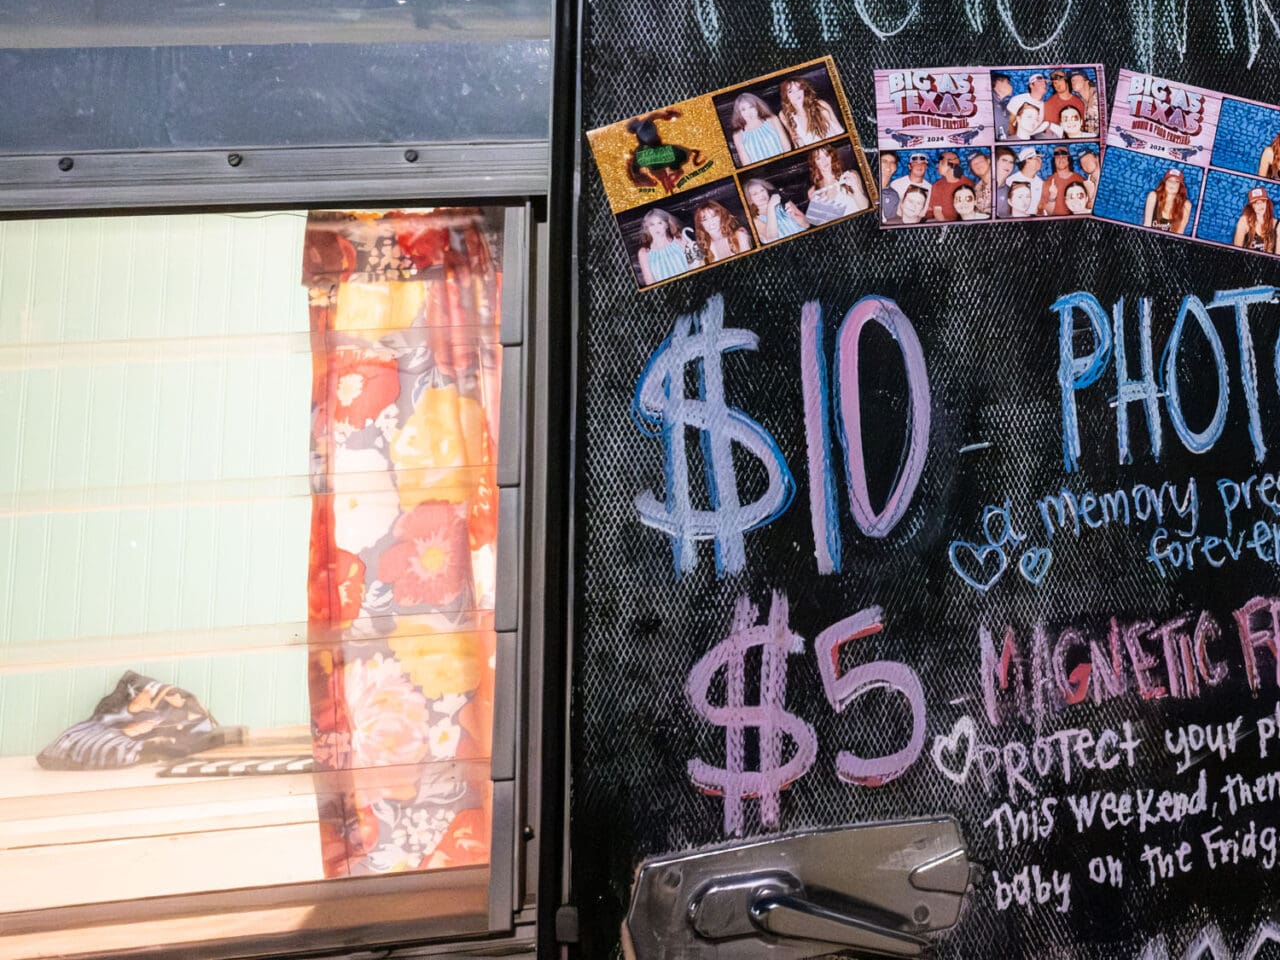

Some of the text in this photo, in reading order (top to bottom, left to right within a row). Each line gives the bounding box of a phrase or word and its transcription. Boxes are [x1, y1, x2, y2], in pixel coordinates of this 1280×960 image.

[889, 71, 975, 94] BIG AS
[891, 90, 977, 118] TEXAS
[1129, 76, 1206, 116] BIG AS
[1127, 94, 1204, 136] TEXAS
[632, 293, 931, 580] $10
[982, 495, 1027, 548] a
[685, 588, 927, 837] $5
[978, 608, 1231, 728] MAGNETIC
[1165, 714, 1243, 774] your
[992, 864, 1072, 916] baby
[1088, 855, 1124, 889] on
